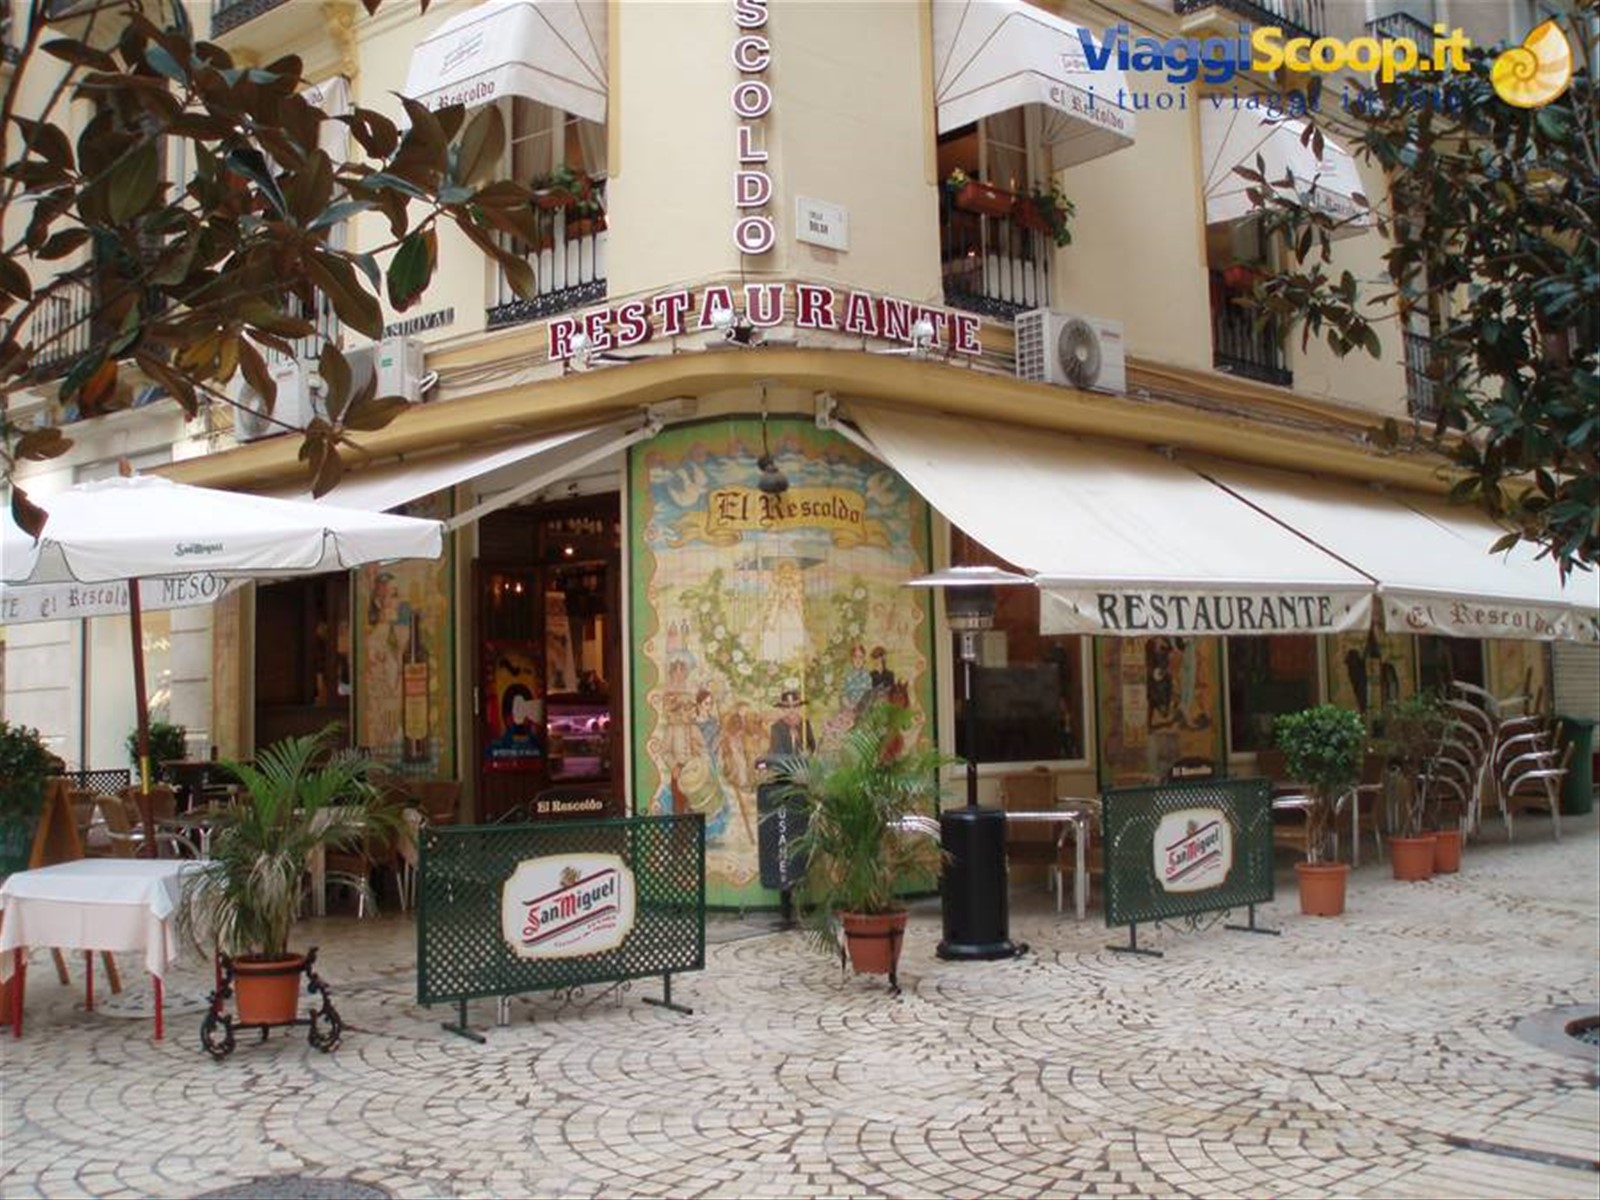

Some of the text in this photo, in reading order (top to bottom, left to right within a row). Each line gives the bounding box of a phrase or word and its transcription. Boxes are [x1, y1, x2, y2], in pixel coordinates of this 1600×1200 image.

[548, 283, 982, 358] RESTAURANTE
[716, 491, 861, 527] El Rescoldo
[1097, 594, 1334, 630] RESTAURANTE
